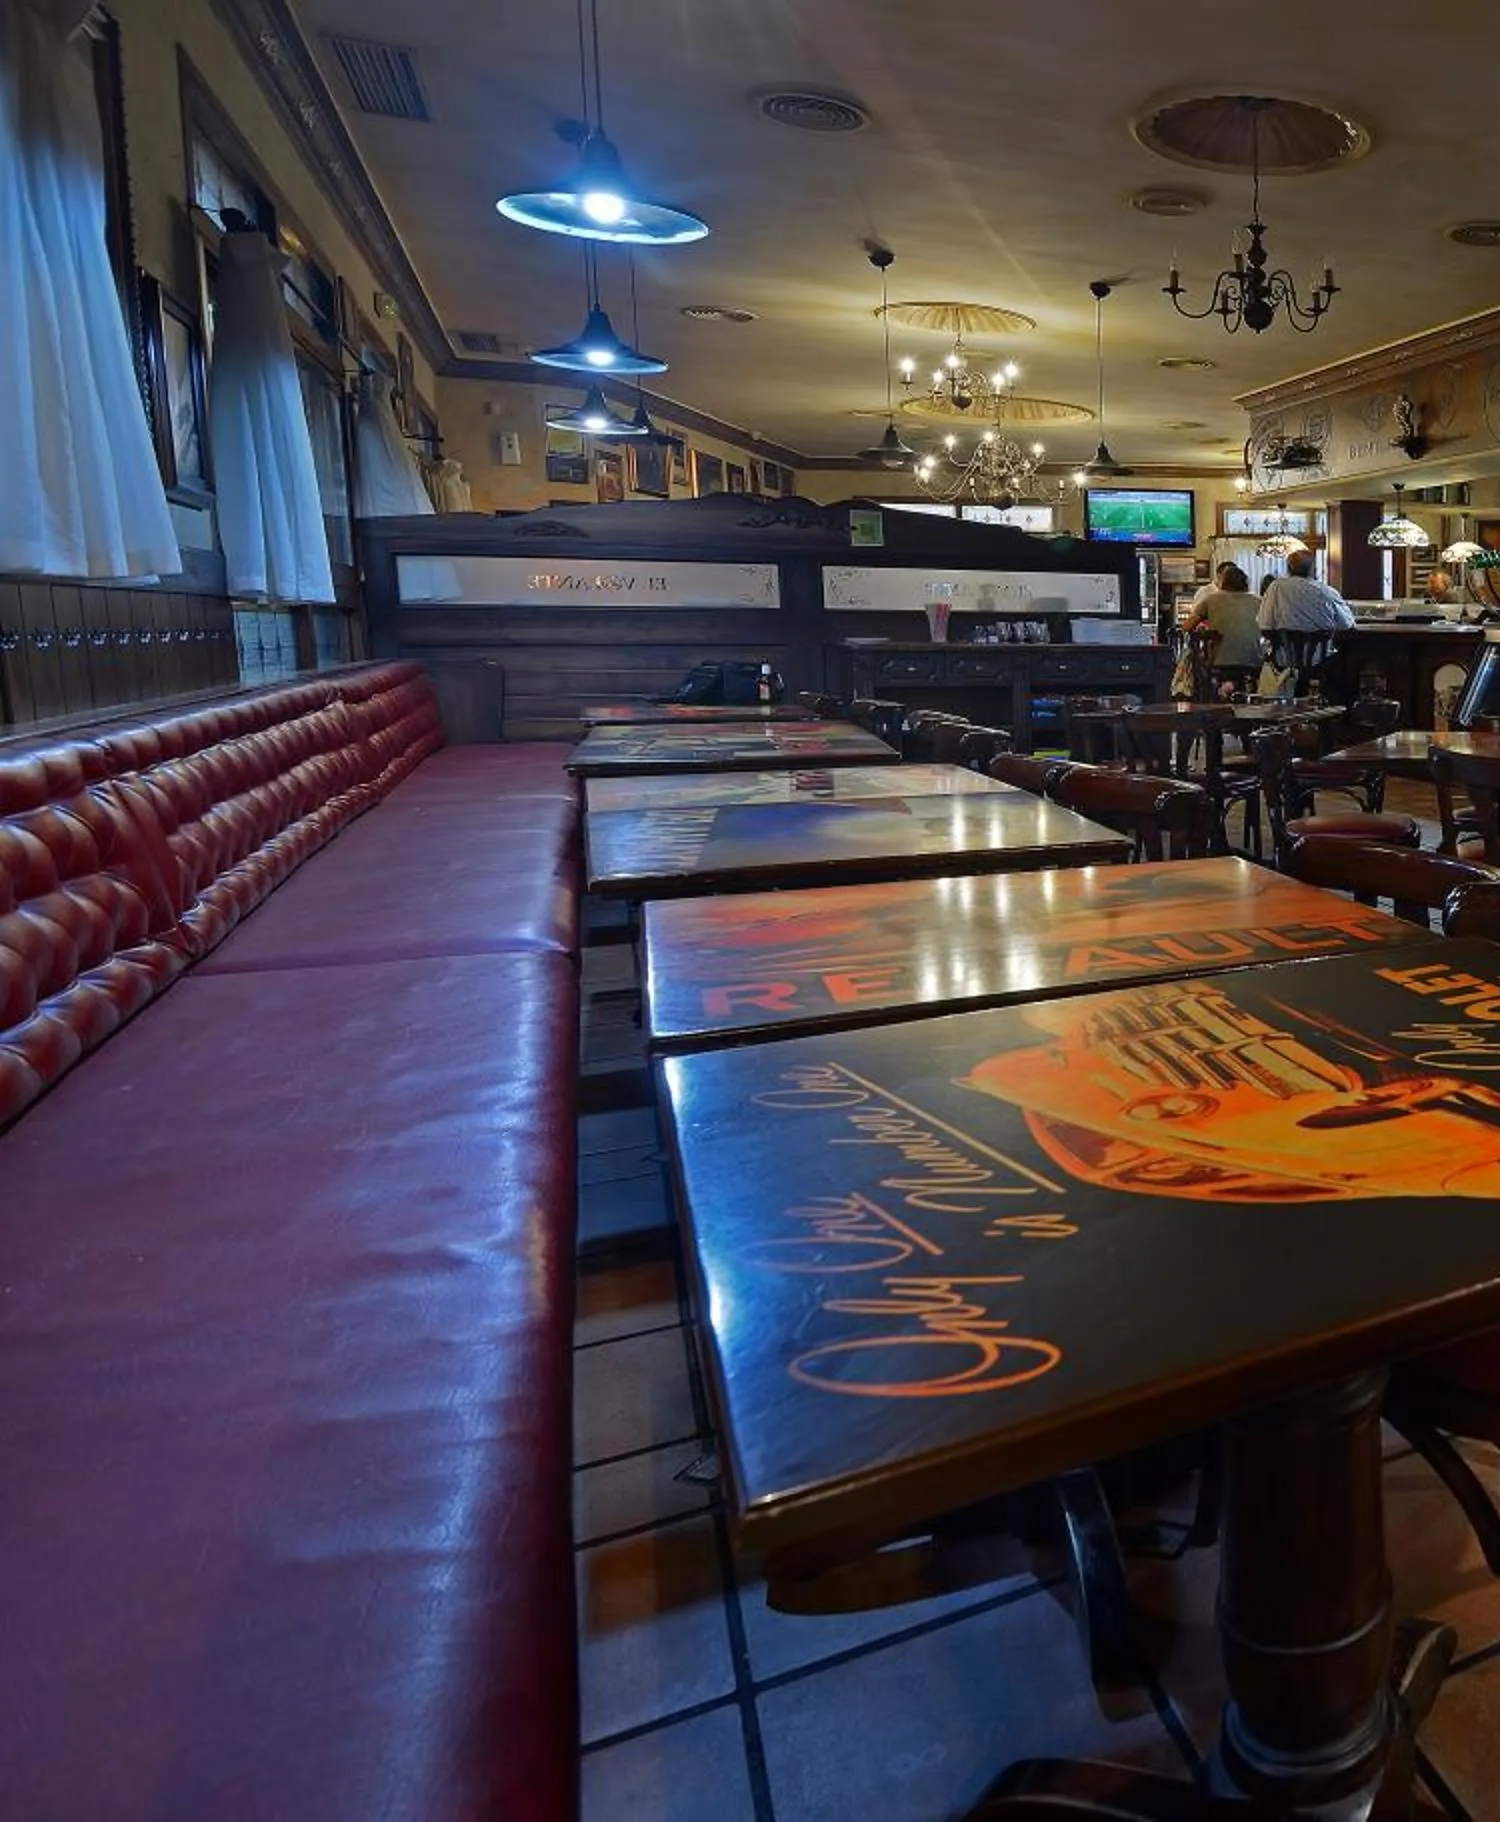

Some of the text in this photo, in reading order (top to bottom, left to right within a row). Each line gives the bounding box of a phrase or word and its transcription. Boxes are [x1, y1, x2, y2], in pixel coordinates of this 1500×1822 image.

[701, 917, 1389, 1016] REAULT
[828, 1106, 1038, 1213] Number
[788, 1275, 1062, 1397] Only
